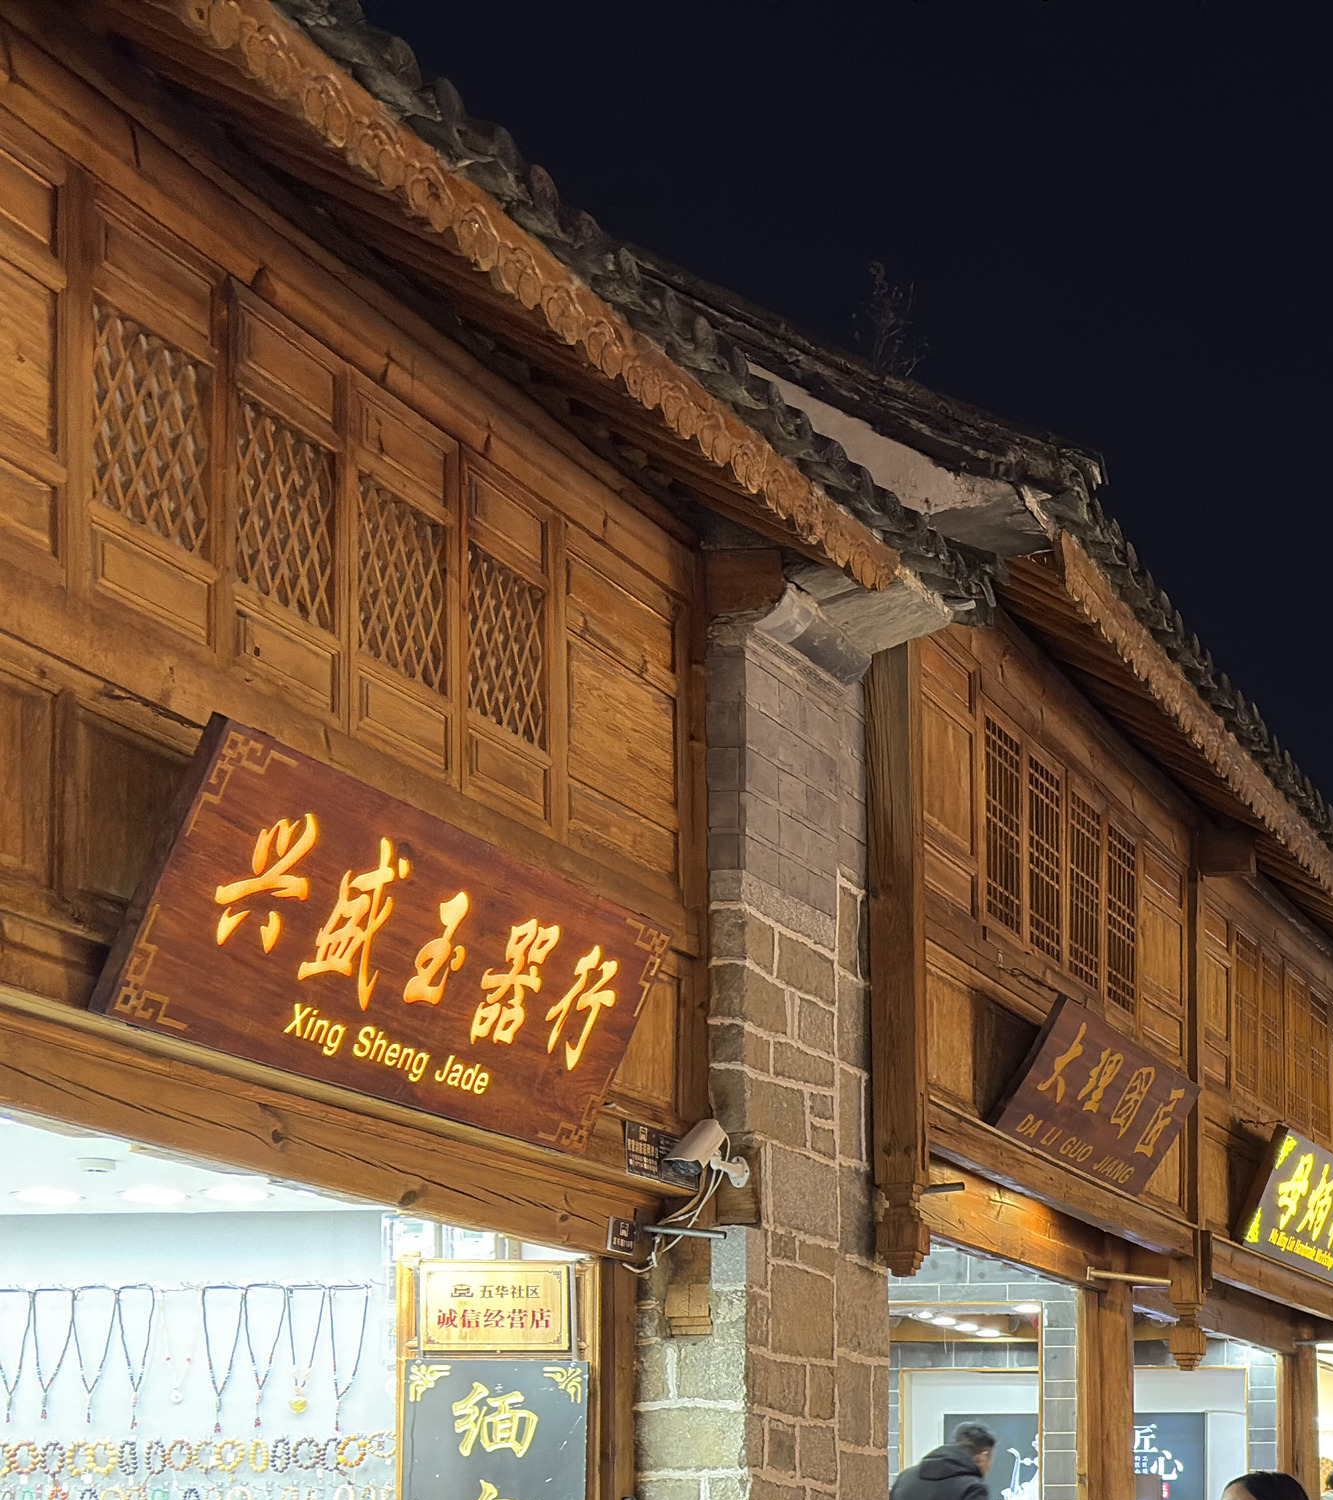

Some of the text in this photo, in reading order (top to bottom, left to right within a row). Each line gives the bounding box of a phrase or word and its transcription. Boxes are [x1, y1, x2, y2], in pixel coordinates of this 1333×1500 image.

[215, 813, 619, 1071] 兴盛玉器行
[284, 1003, 490, 1096] Xing Sheng Jade
[1015, 1113, 1136, 1184] DA LI GUO JIANG
[436, 1308, 552, 1329] 诚信经营店
[479, 1285, 540, 1299] 五华社区
[1133, 1424, 1184, 1481] 匠心
